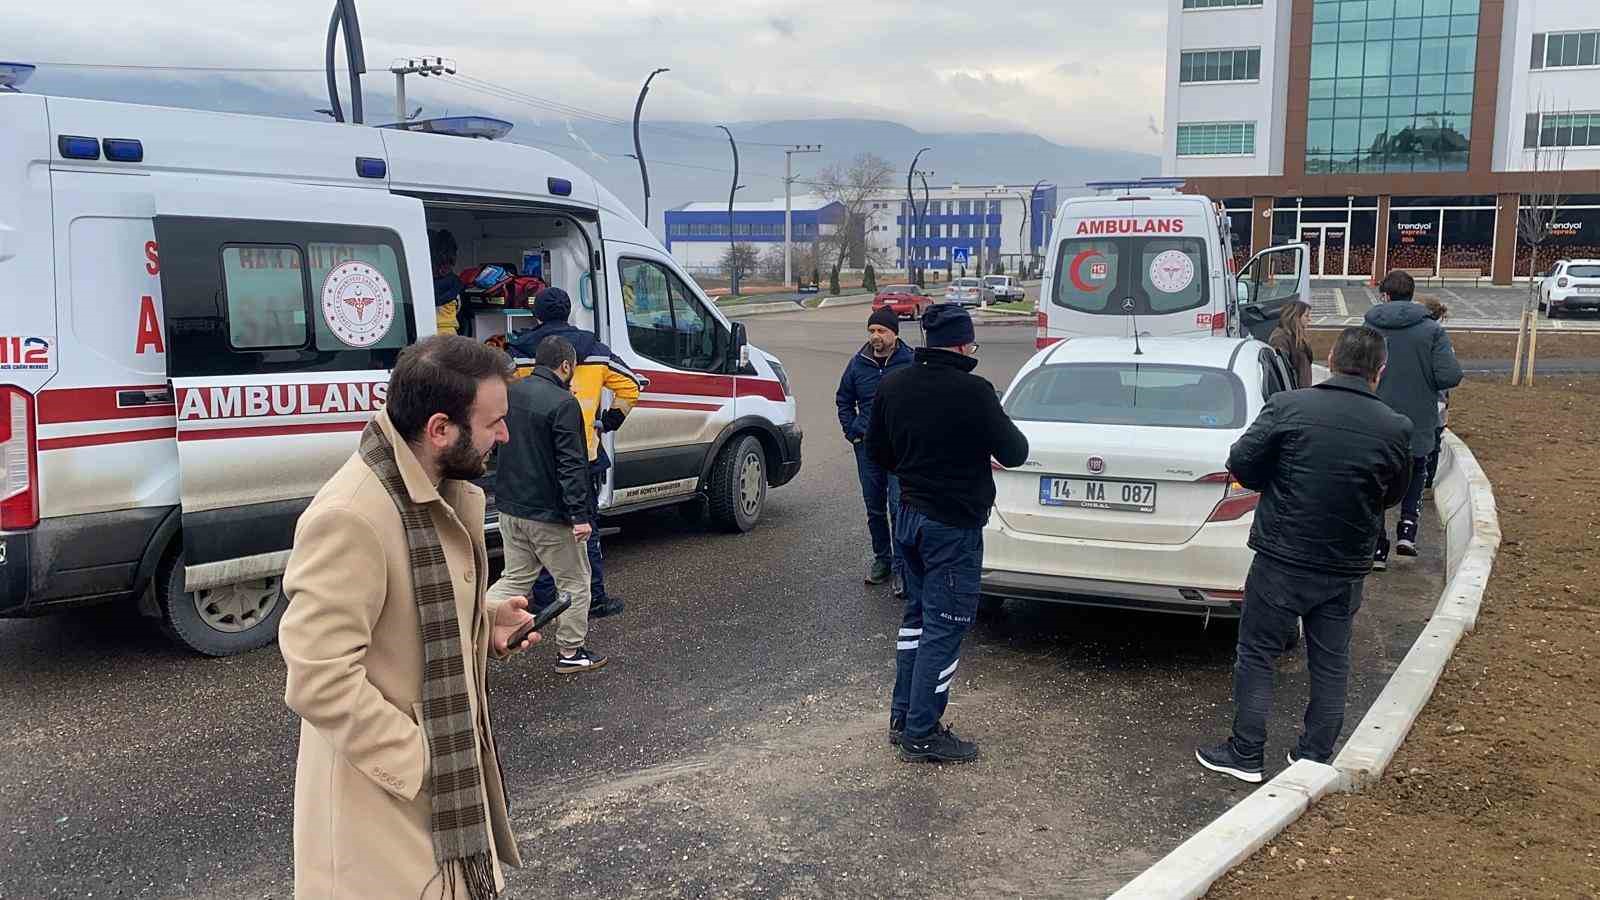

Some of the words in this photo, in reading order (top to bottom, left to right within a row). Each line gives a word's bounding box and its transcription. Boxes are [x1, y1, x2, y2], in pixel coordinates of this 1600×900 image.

[1076, 218, 1184, 234] AMBULANS
[1397, 222, 1432, 230] trendyol
[1545, 222, 1582, 230] tendyol
[0, 337, 48, 363] 112
[180, 383, 388, 420] AMBULANS
[1053, 480, 1071, 498] 14
[1086, 482, 1105, 500] NA
[1122, 485, 1152, 503] 087
